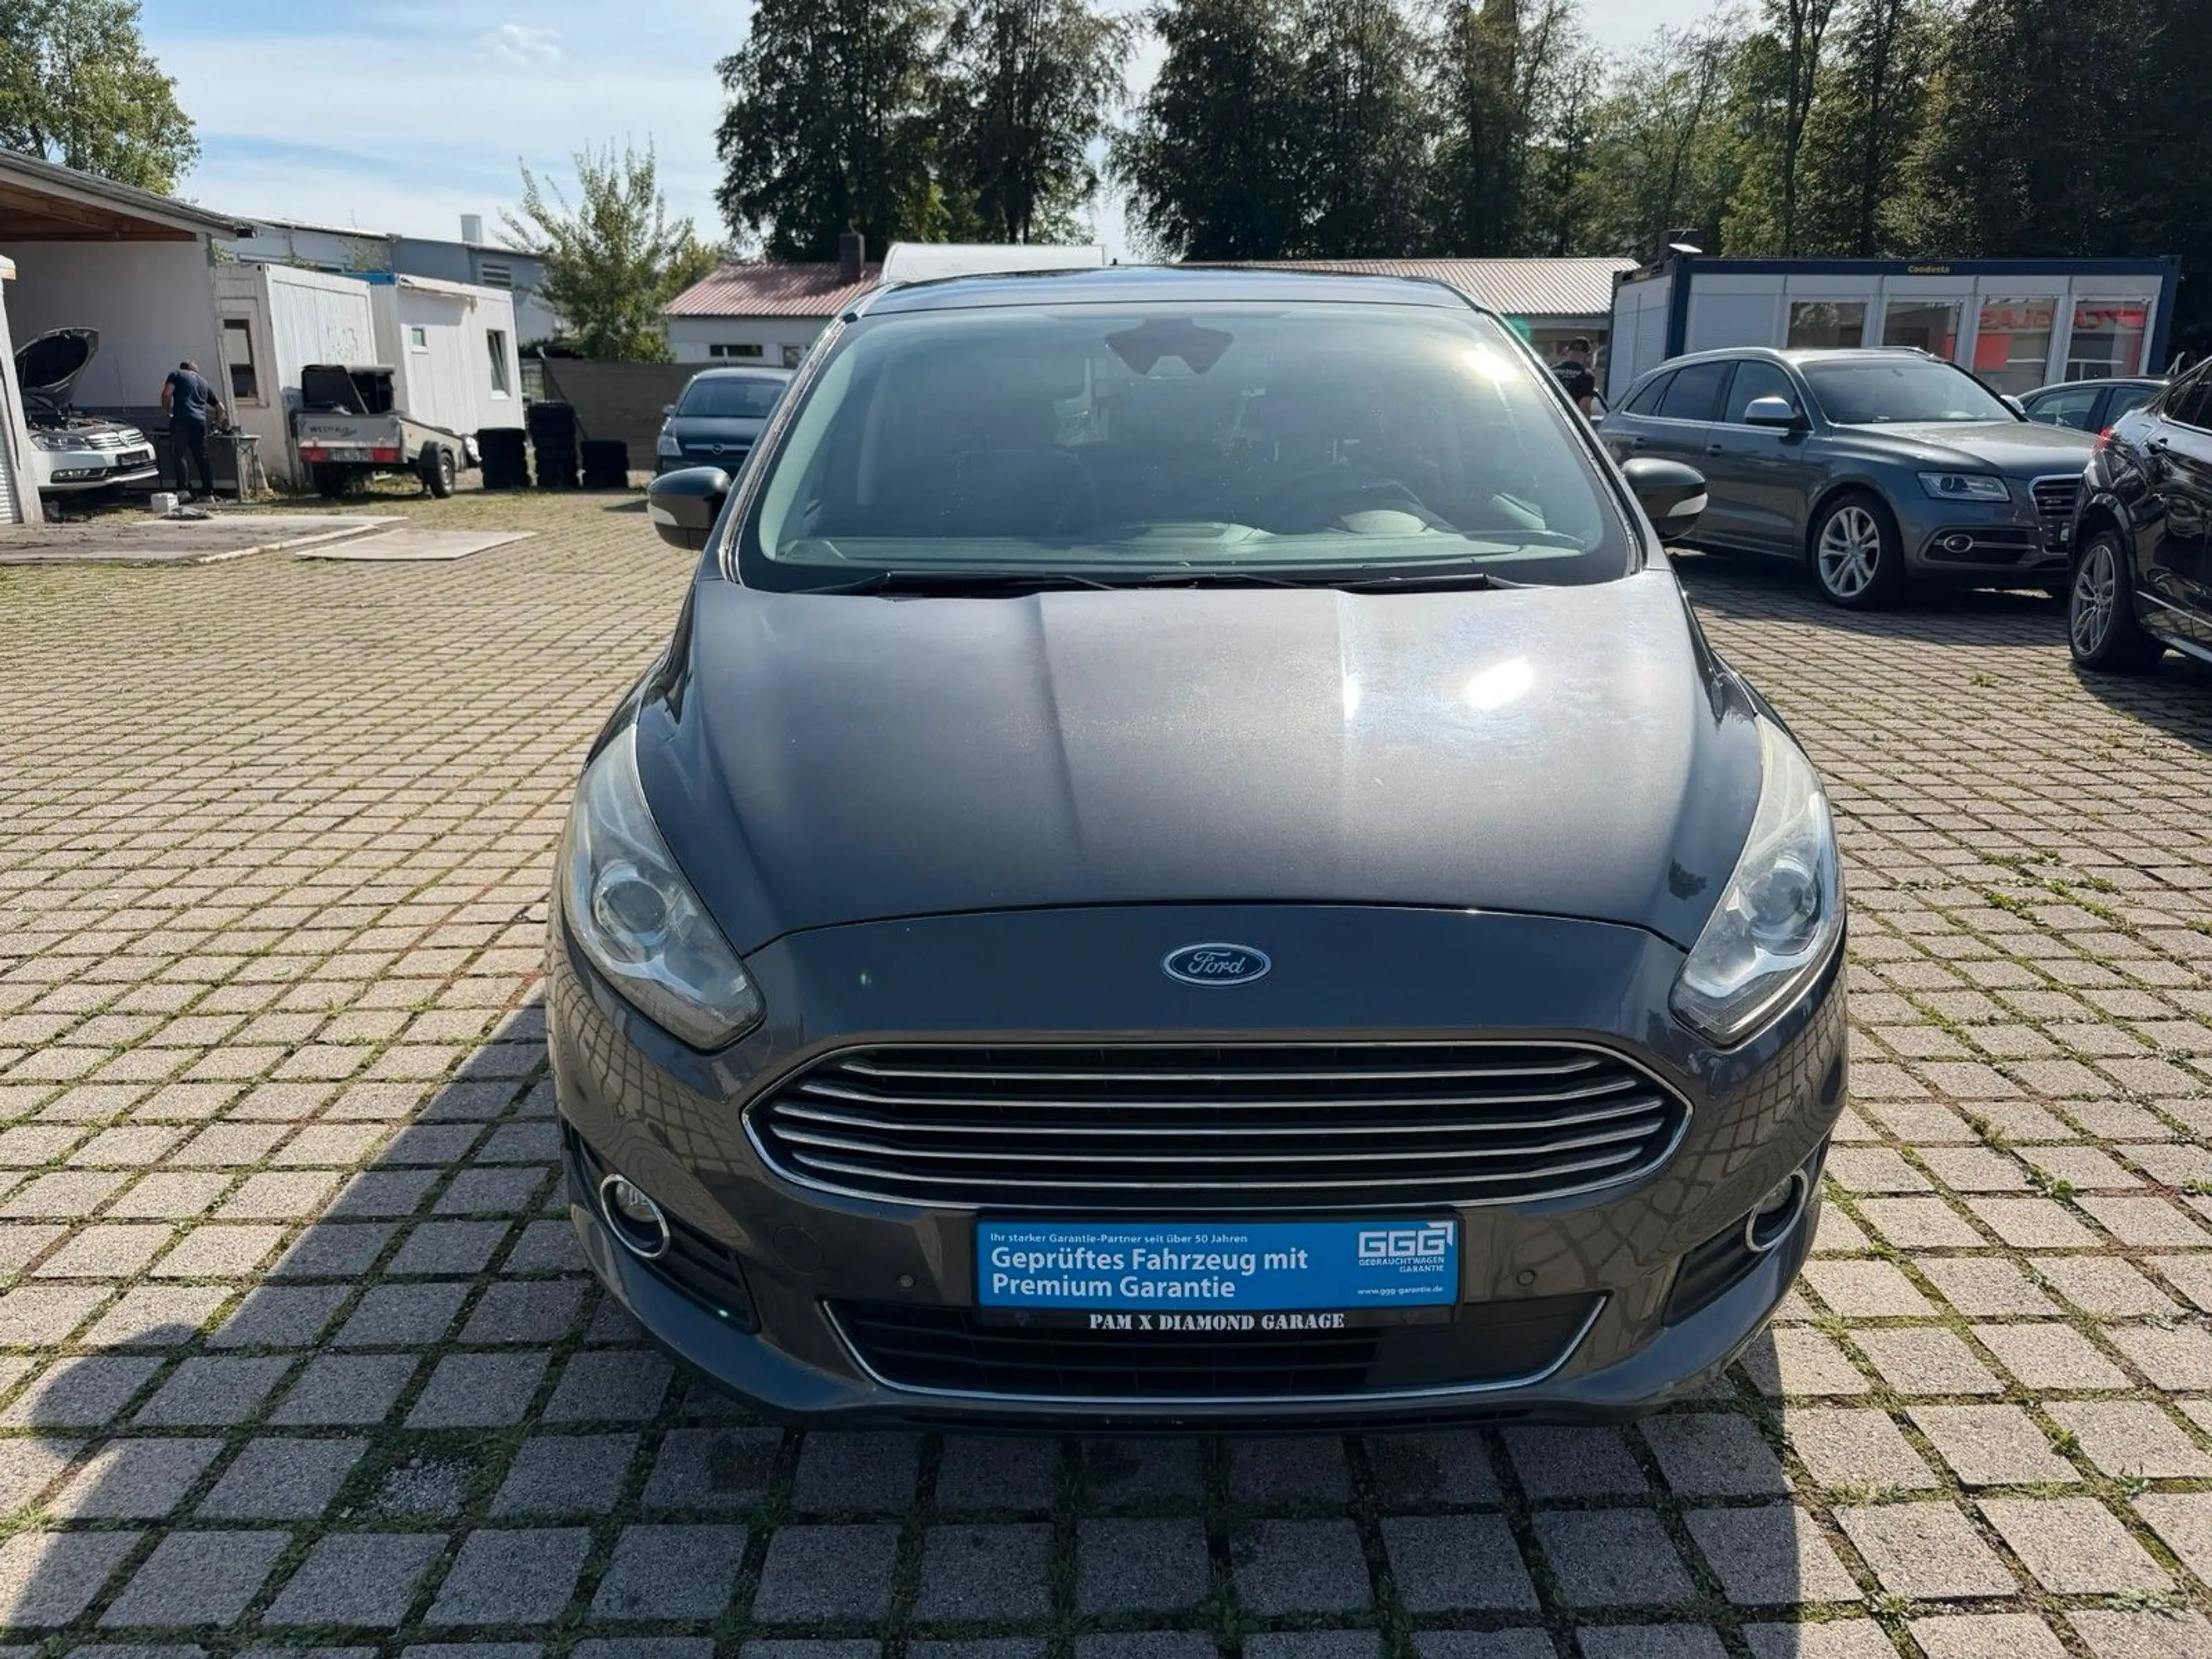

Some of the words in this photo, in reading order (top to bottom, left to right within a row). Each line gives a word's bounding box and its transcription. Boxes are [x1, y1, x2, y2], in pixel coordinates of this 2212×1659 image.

[1187, 950, 1246, 974] Ford
[990, 1233, 1005, 1241] Ihr
[1009, 1233, 1046, 1243] starker
[1049, 1234, 1142, 1244] Garantie-Partner
[1144, 1234, 1164, 1244] seit
[1166, 1234, 1192, 1244] über
[1195, 1234, 1208, 1244] 50
[1211, 1234, 1248, 1244] Jahren
[1358, 1229, 1446, 1258] GGG
[991, 1247, 1125, 1274] Geprüftes
[1132, 1247, 1256, 1276] Fahrzeug
[1264, 1247, 1308, 1270] mit
[1358, 1257, 1445, 1266] GEBRAUCHTWAGEN
[1399, 1265, 1444, 1273] GARANTIE
[992, 1273, 1112, 1297] Premium
[1119, 1276, 1236, 1298] Garantie
[1357, 1285, 1444, 1296] www.ggg-garantie.de
[1089, 1313, 1132, 1330] PAM
[1138, 1315, 1153, 1330] X
[1158, 1315, 1255, 1330] DIAMOND
[1262, 1313, 1345, 1330] GARAGE
